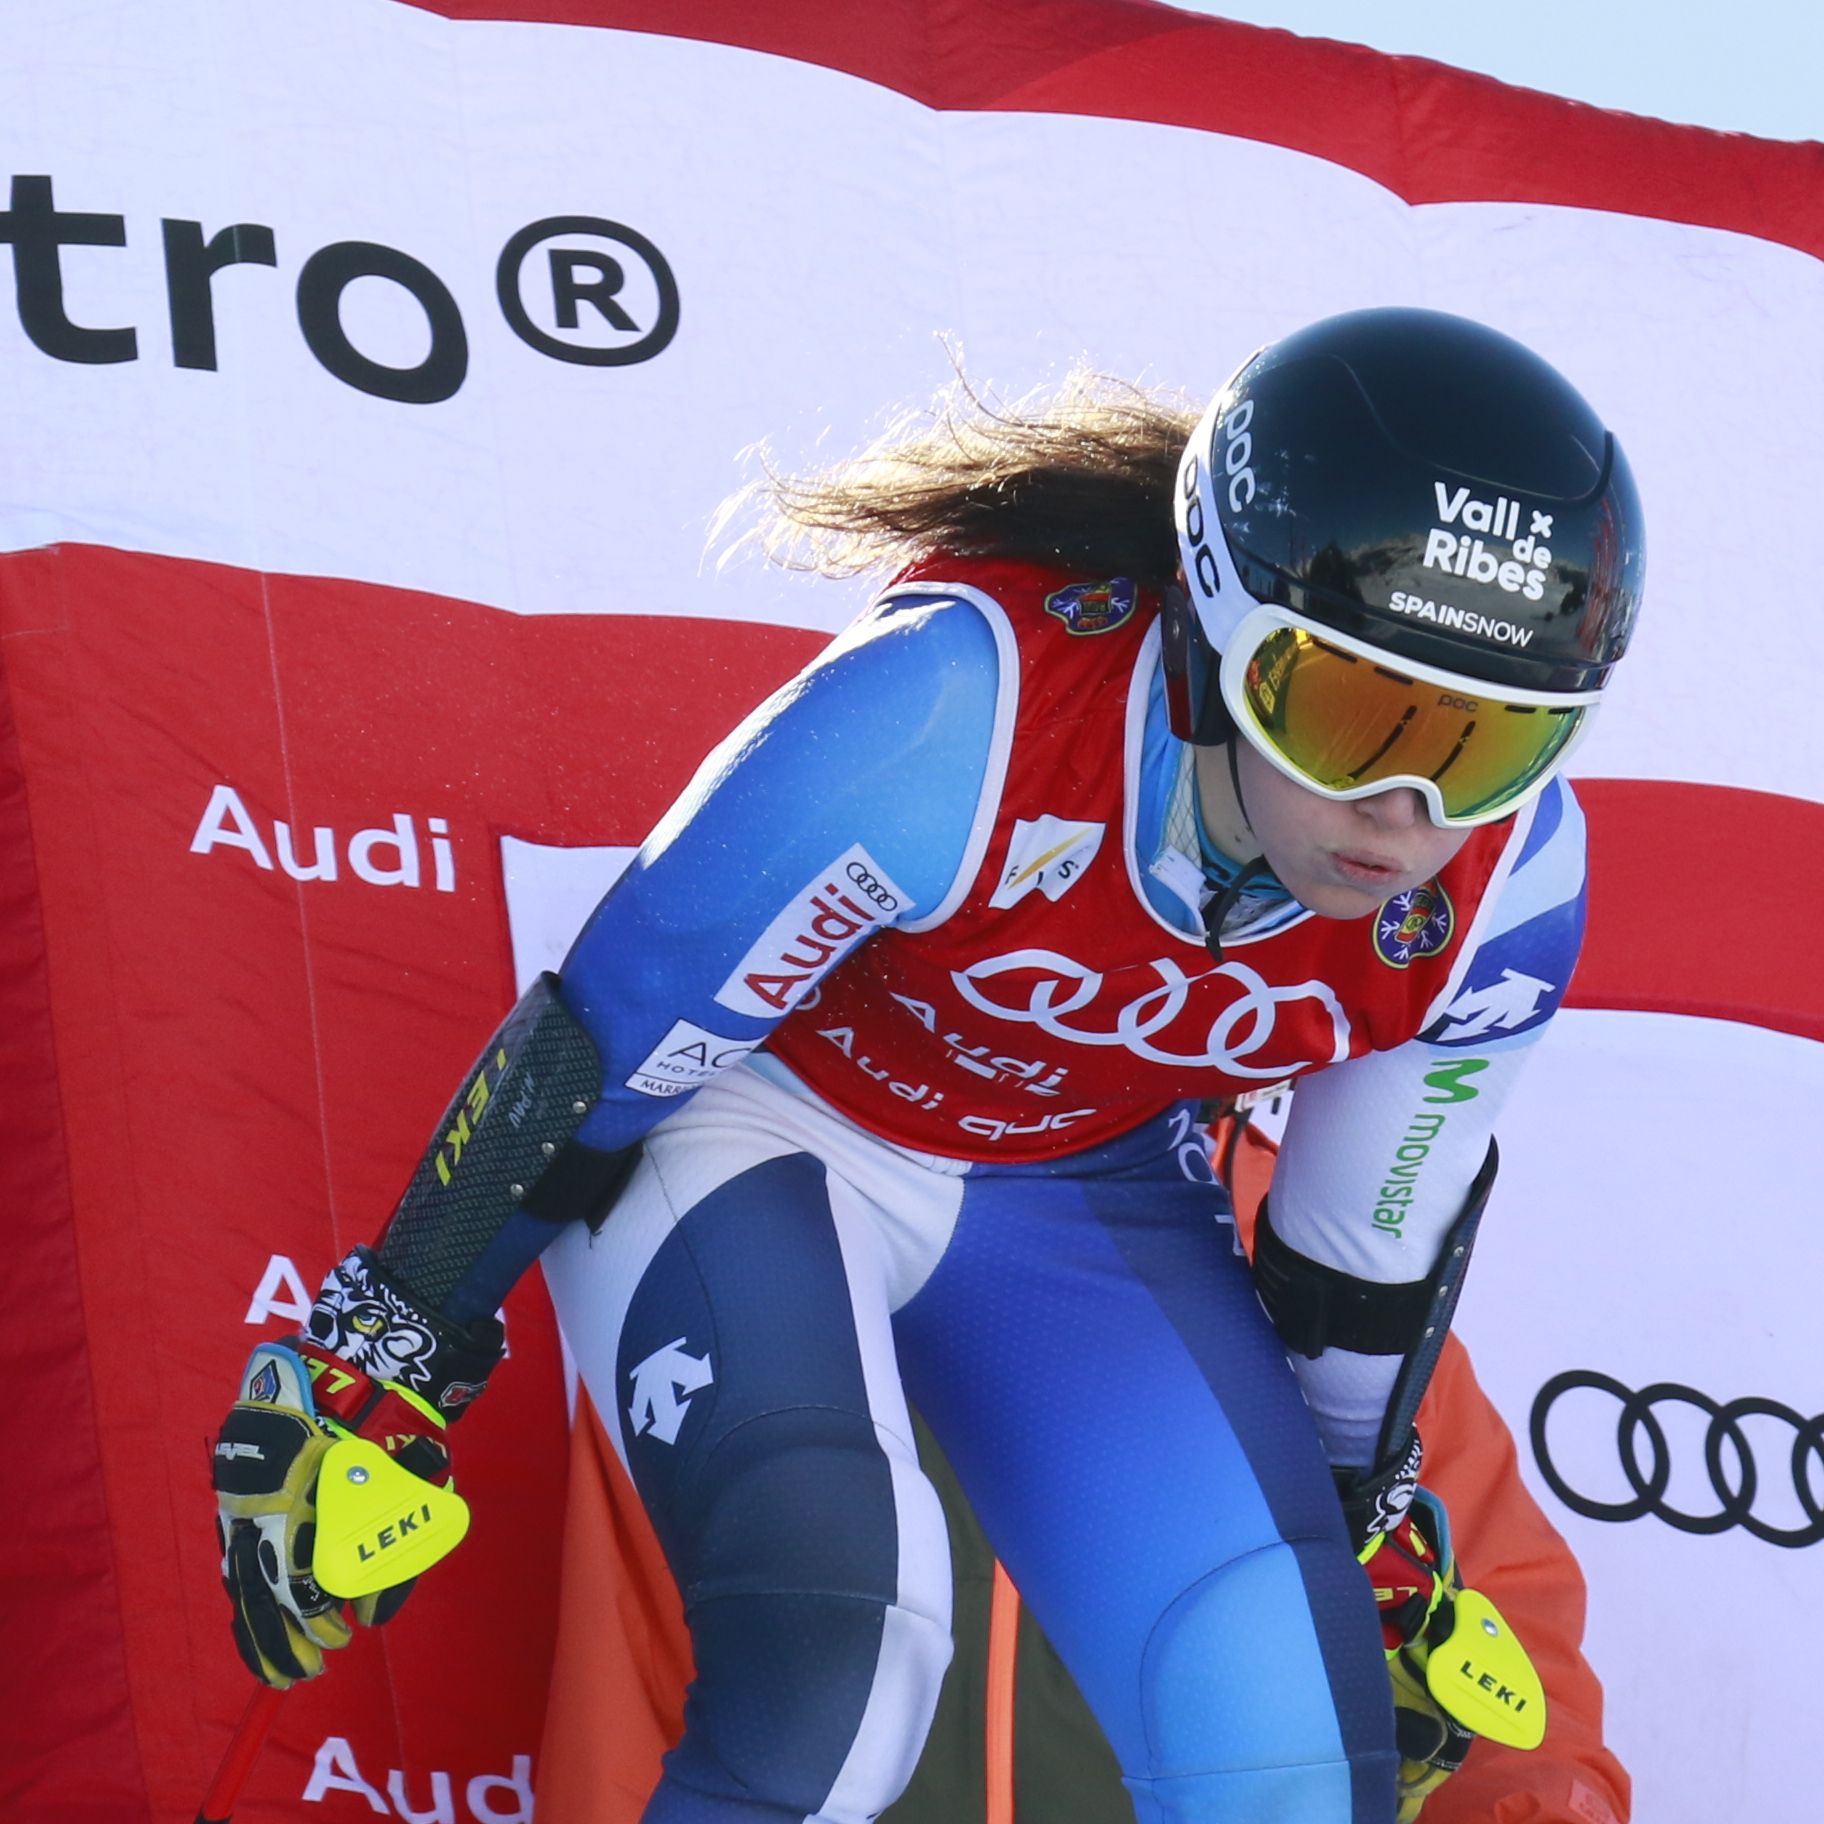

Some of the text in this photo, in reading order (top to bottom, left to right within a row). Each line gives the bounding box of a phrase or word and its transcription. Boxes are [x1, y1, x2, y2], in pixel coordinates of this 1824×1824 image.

[1434, 481, 1521, 541] Vall
[1423, 528, 1546, 601] Ribes
[1512, 535, 1552, 569] de
[190, 783, 456, 893] Audi
[743, 883, 877, 1011] Audi
[816, 1026, 944, 1110] Audi
[1371, 1113, 1446, 1239] movistar
[357, 1503, 432, 1563] LEKI
[1459, 1660, 1527, 1713] LEKI
